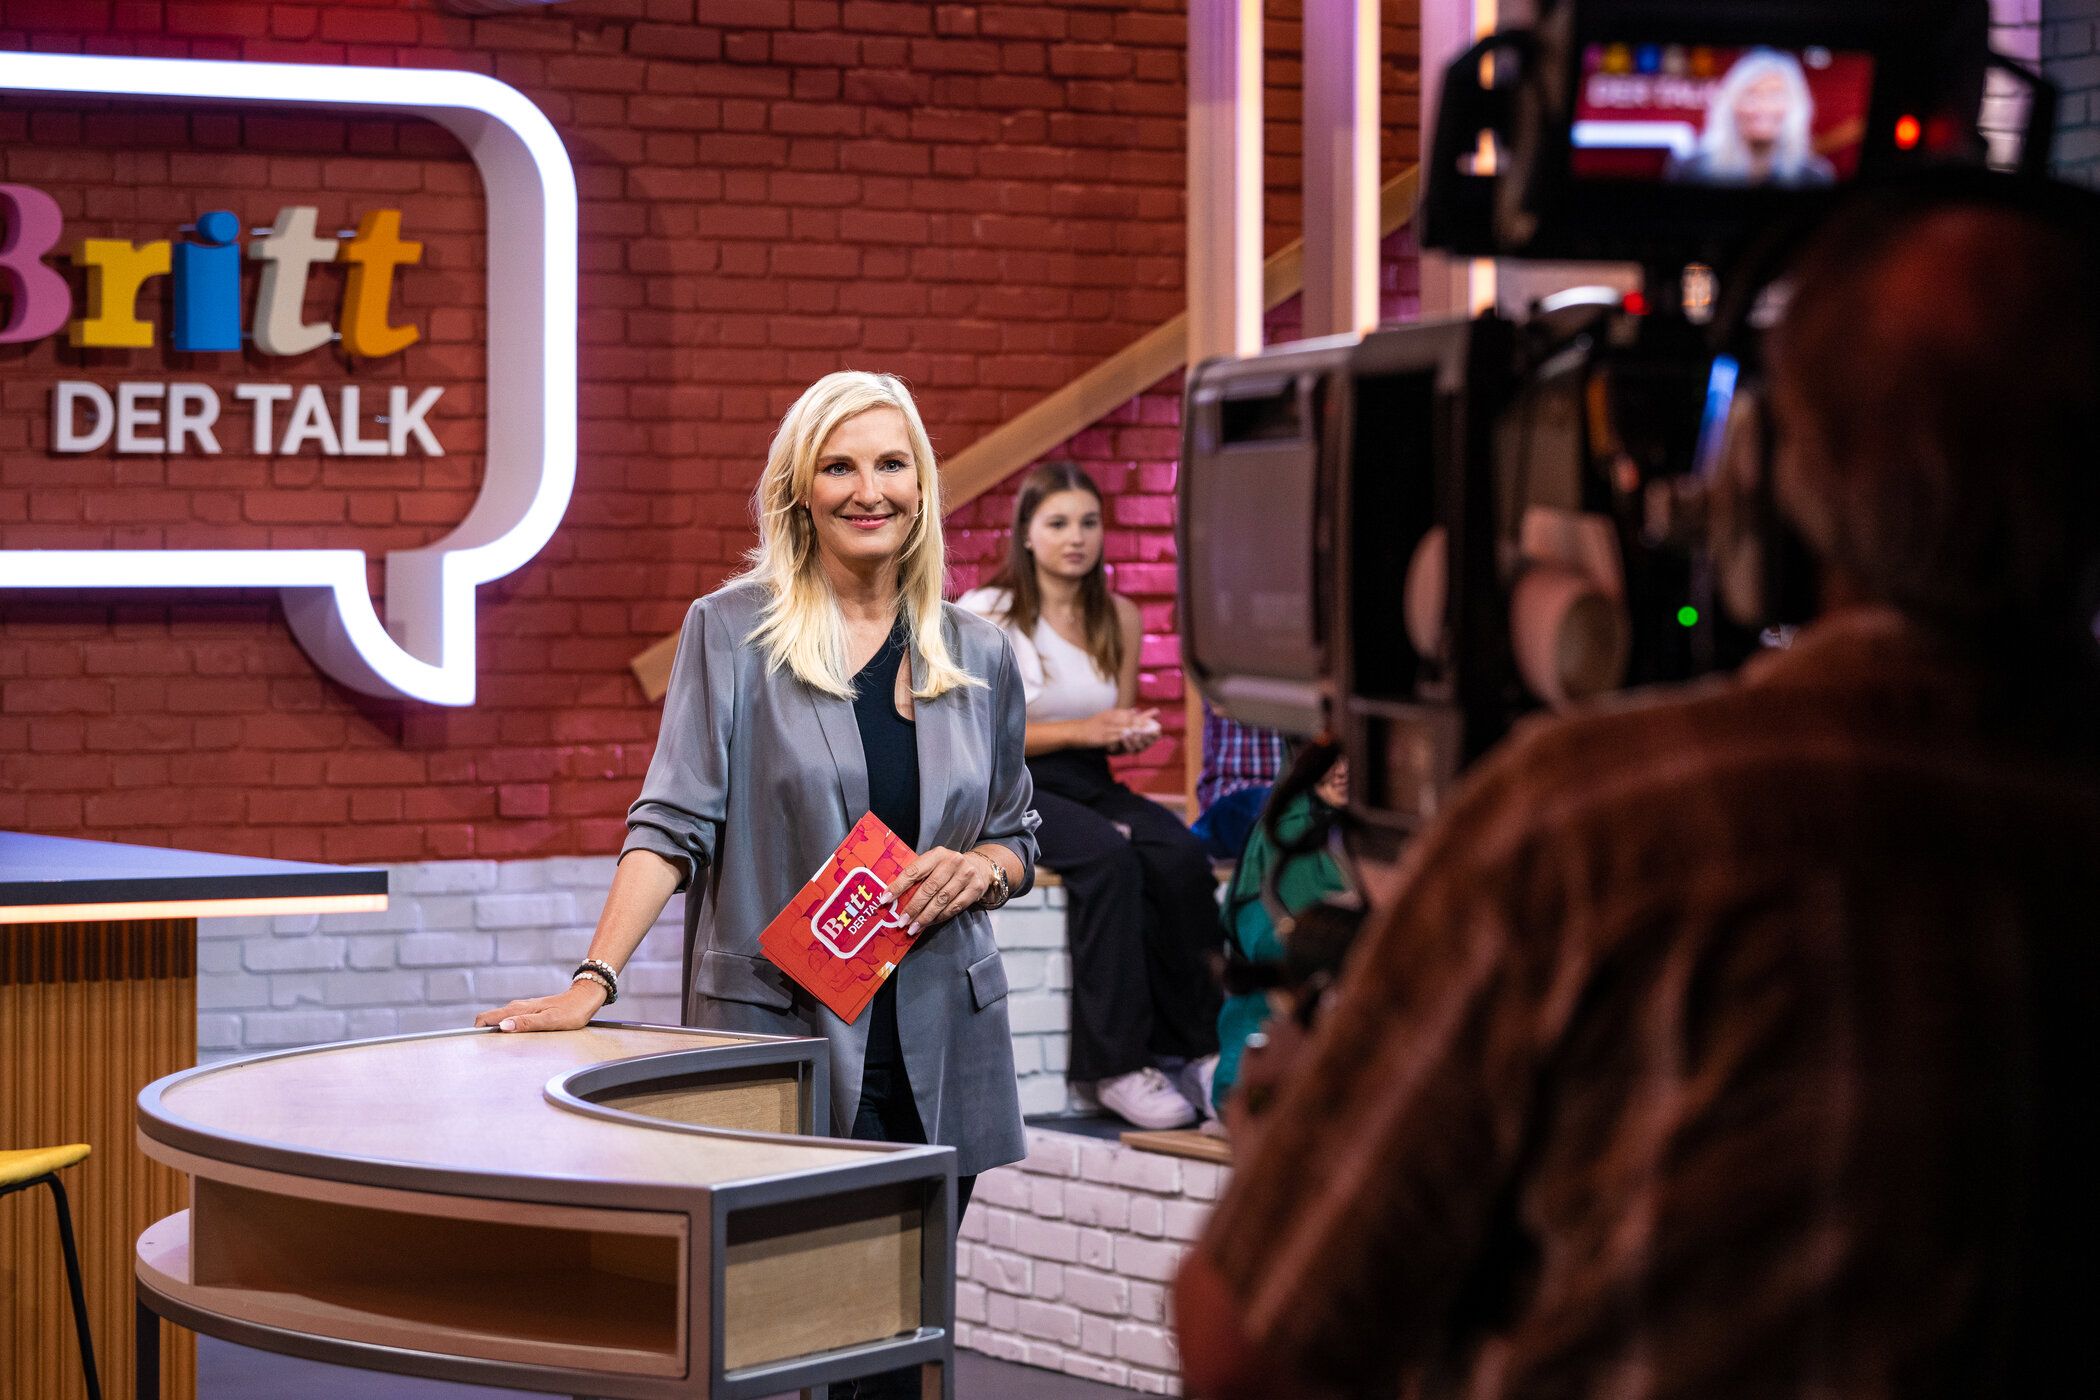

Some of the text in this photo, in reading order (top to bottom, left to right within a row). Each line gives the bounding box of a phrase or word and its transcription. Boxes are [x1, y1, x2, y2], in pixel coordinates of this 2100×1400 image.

[55, 381, 445, 456] DER TALK
[821, 884, 873, 940] Britt
[847, 915, 868, 935] DER
